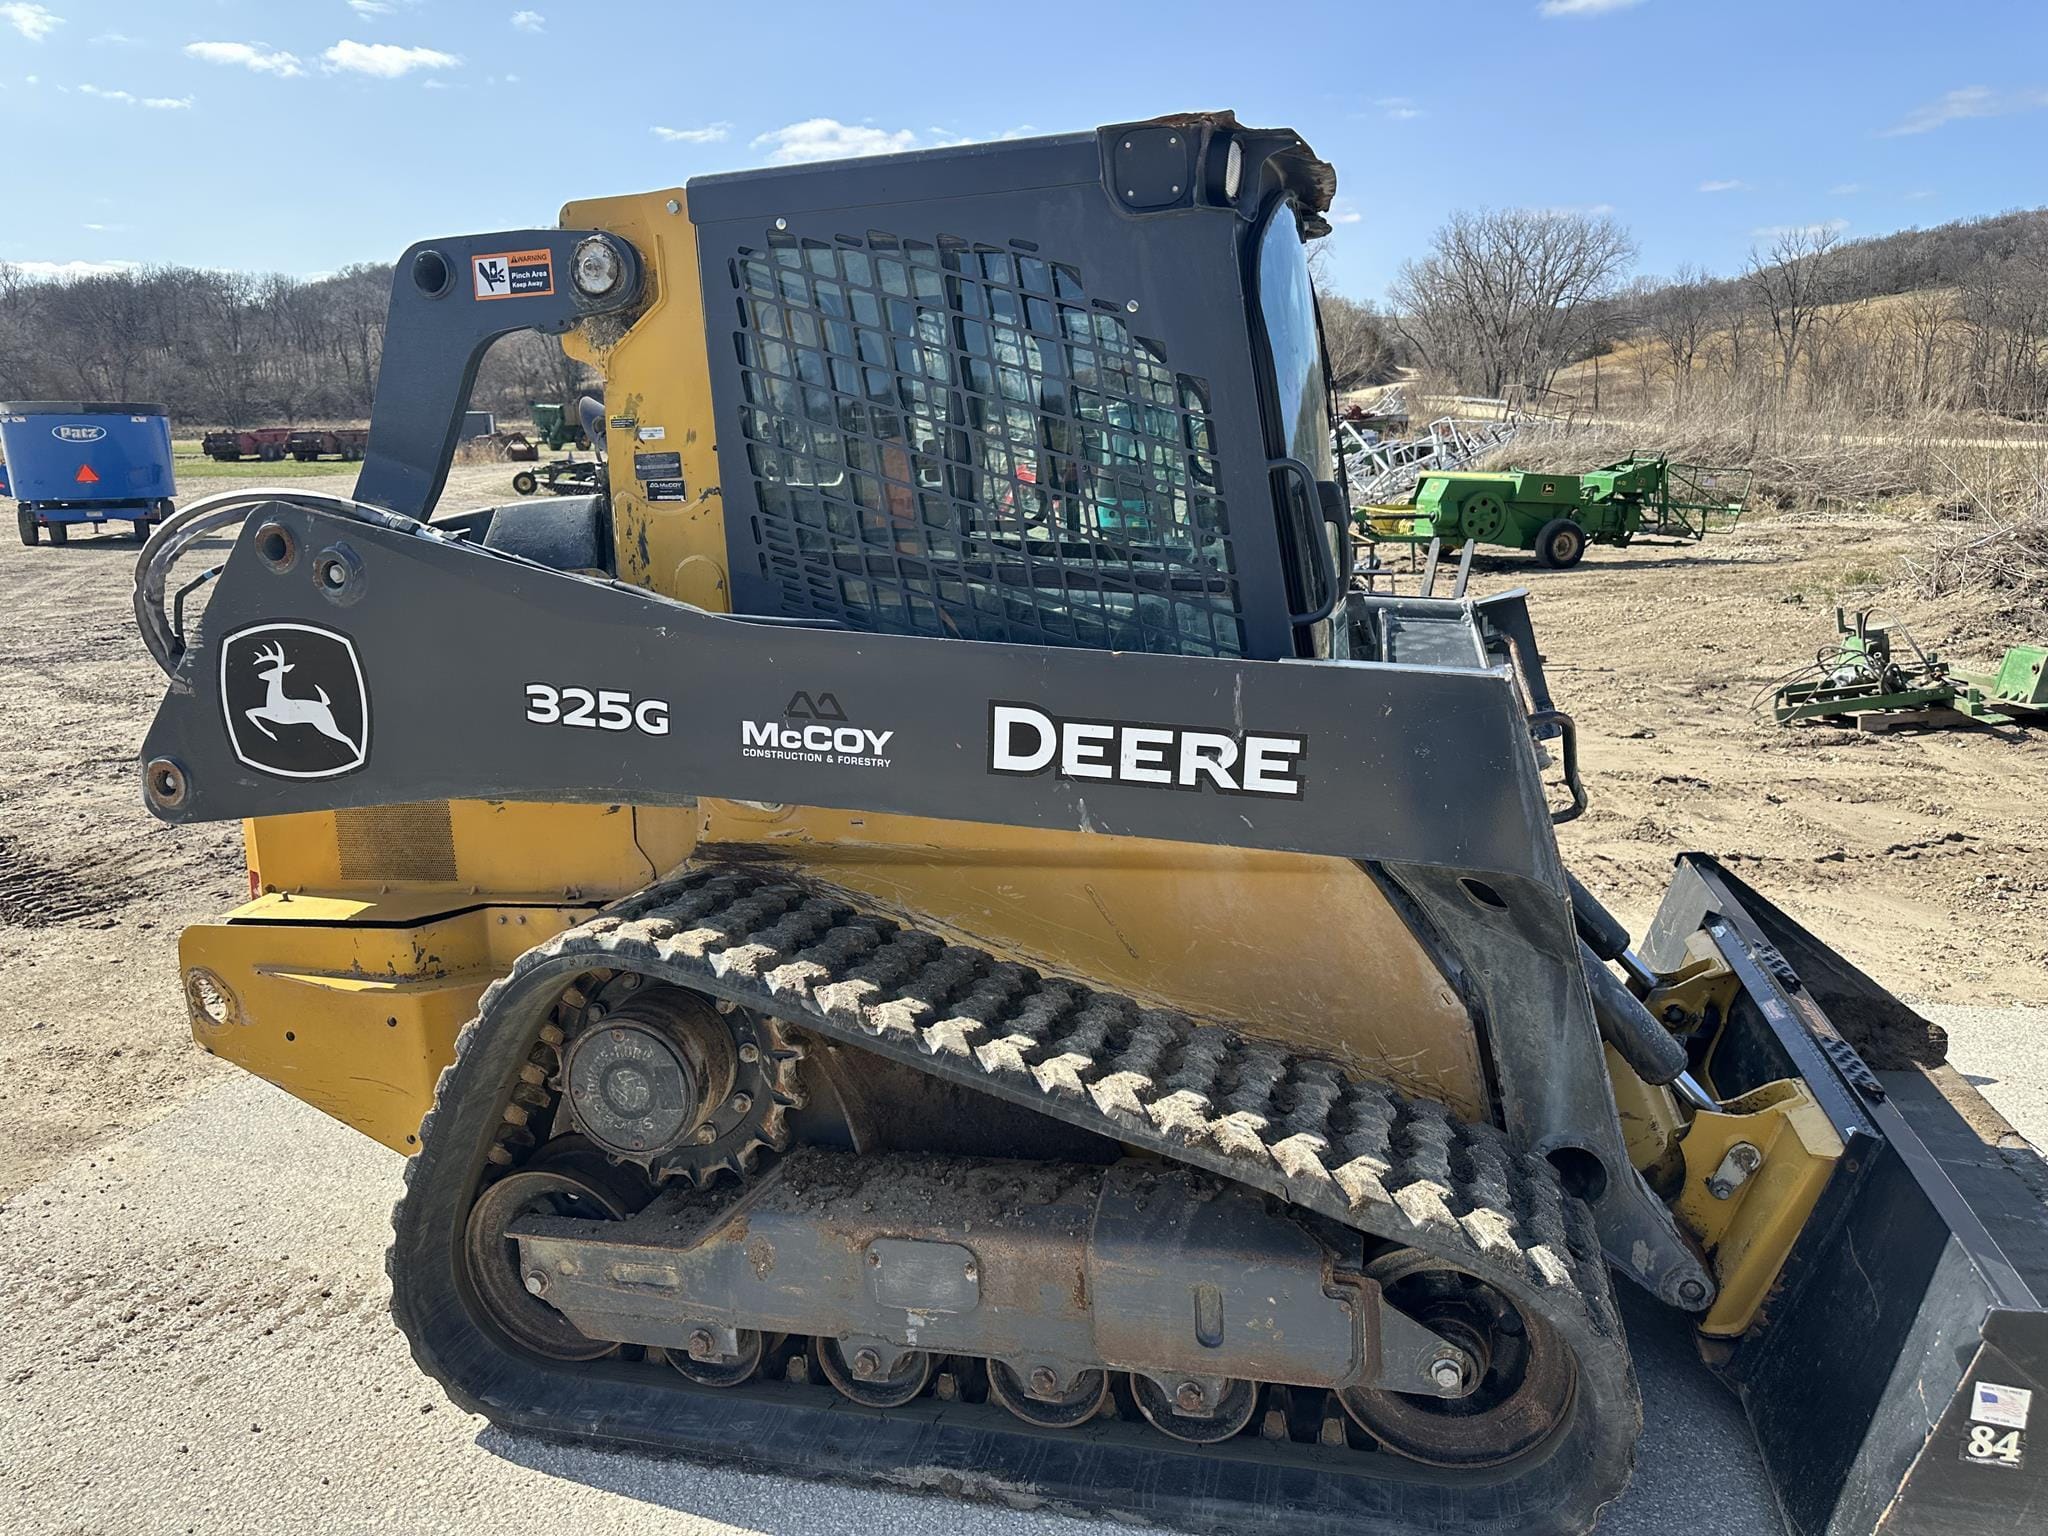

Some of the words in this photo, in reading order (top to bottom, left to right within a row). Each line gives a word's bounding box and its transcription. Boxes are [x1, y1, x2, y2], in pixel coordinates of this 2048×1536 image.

[518, 254, 548, 262] WARNING
[511, 271, 530, 279] Pinch
[531, 270, 548, 278] Area
[512, 281, 527, 289] Keep
[527, 280, 543, 288] Away
[525, 684, 669, 735] 325G
[741, 721, 893, 756] McCOY
[993, 706, 1301, 794] DEERE
[742, 748, 822, 763] CONSTRUCTION
[826, 755, 834, 764] &
[837, 755, 892, 768] FORESTRY
[1968, 1426, 2022, 1463] 84
